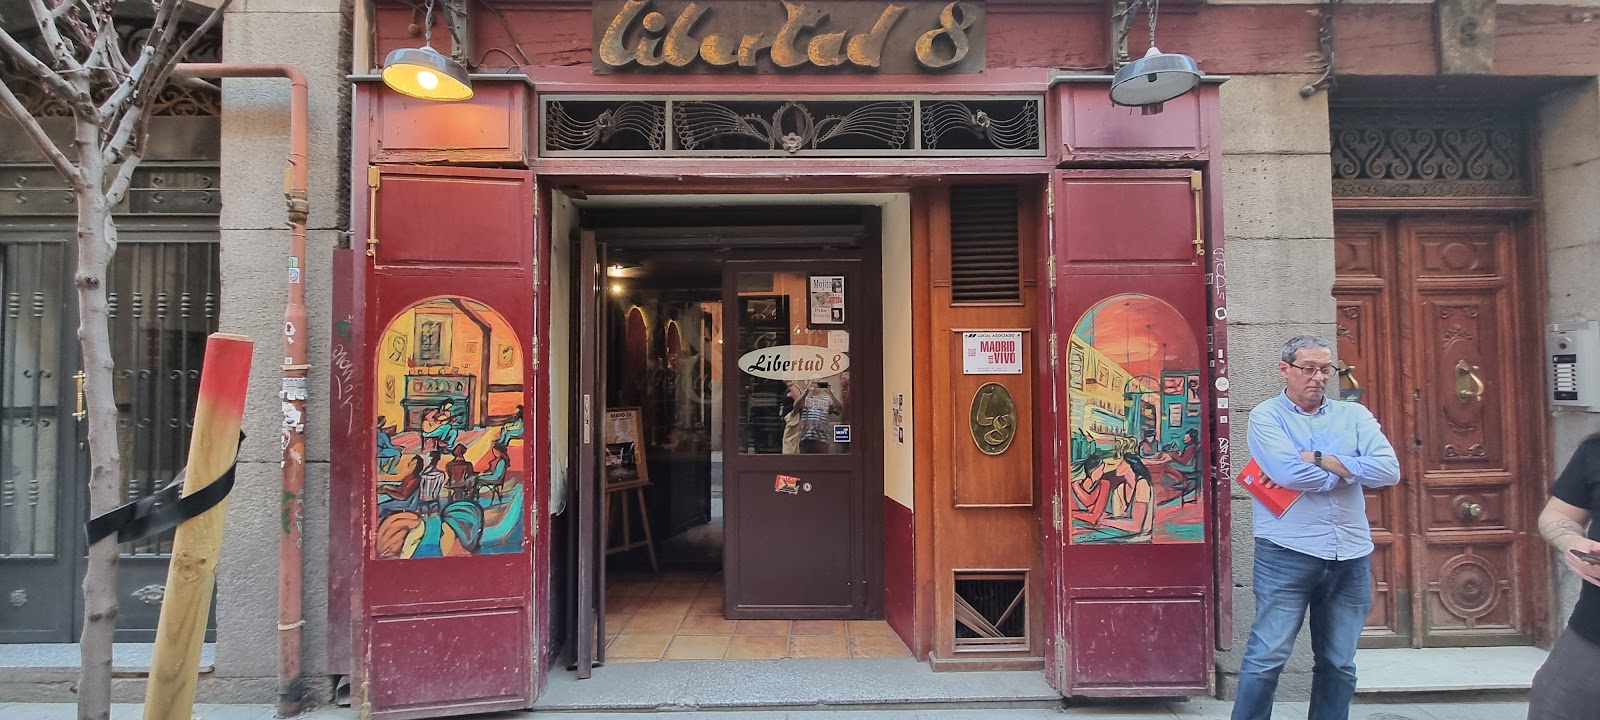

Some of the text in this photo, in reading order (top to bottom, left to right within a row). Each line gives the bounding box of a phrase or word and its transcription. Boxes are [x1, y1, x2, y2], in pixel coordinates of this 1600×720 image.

[599, 0, 976, 68] Libertad 8
[980, 340, 1016, 353] MADRID
[747, 353, 842, 372] Libertad 8
[994, 352, 1016, 365] VIVO
